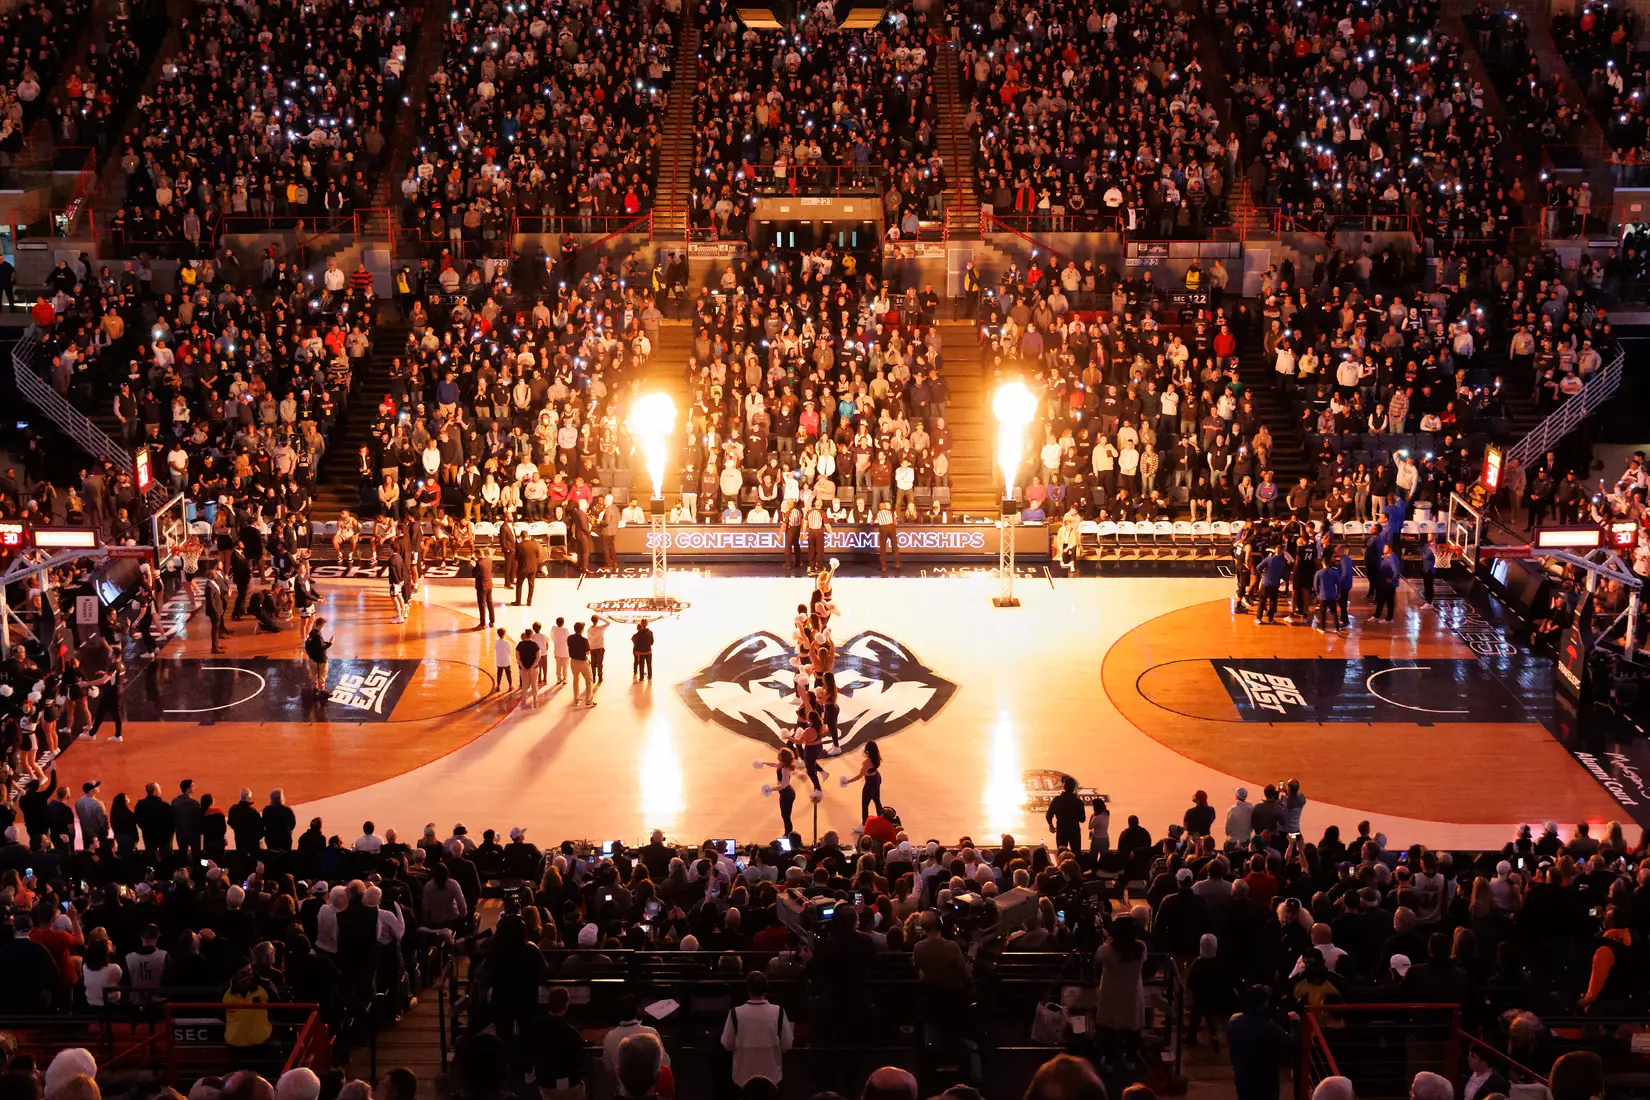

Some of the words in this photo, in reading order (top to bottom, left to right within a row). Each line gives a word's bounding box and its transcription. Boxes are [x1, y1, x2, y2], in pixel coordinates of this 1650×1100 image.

[1188, 294, 1207, 304] 122
[3, 532, 19, 545] 30
[675, 532, 809, 549] CONFERENE
[823, 532, 985, 549] CHAMONSHIPS
[1616, 532, 1632, 544] 30
[327, 673, 365, 705] BIG
[350, 665, 393, 711] EAST
[1238, 669, 1288, 714] EAST
[1263, 673, 1309, 706] BIG
[1573, 751, 1618, 781] Alumni
[1603, 781, 1640, 806] Court
[140, 961, 152, 980] 15
[173, 1029, 209, 1041] SEC
